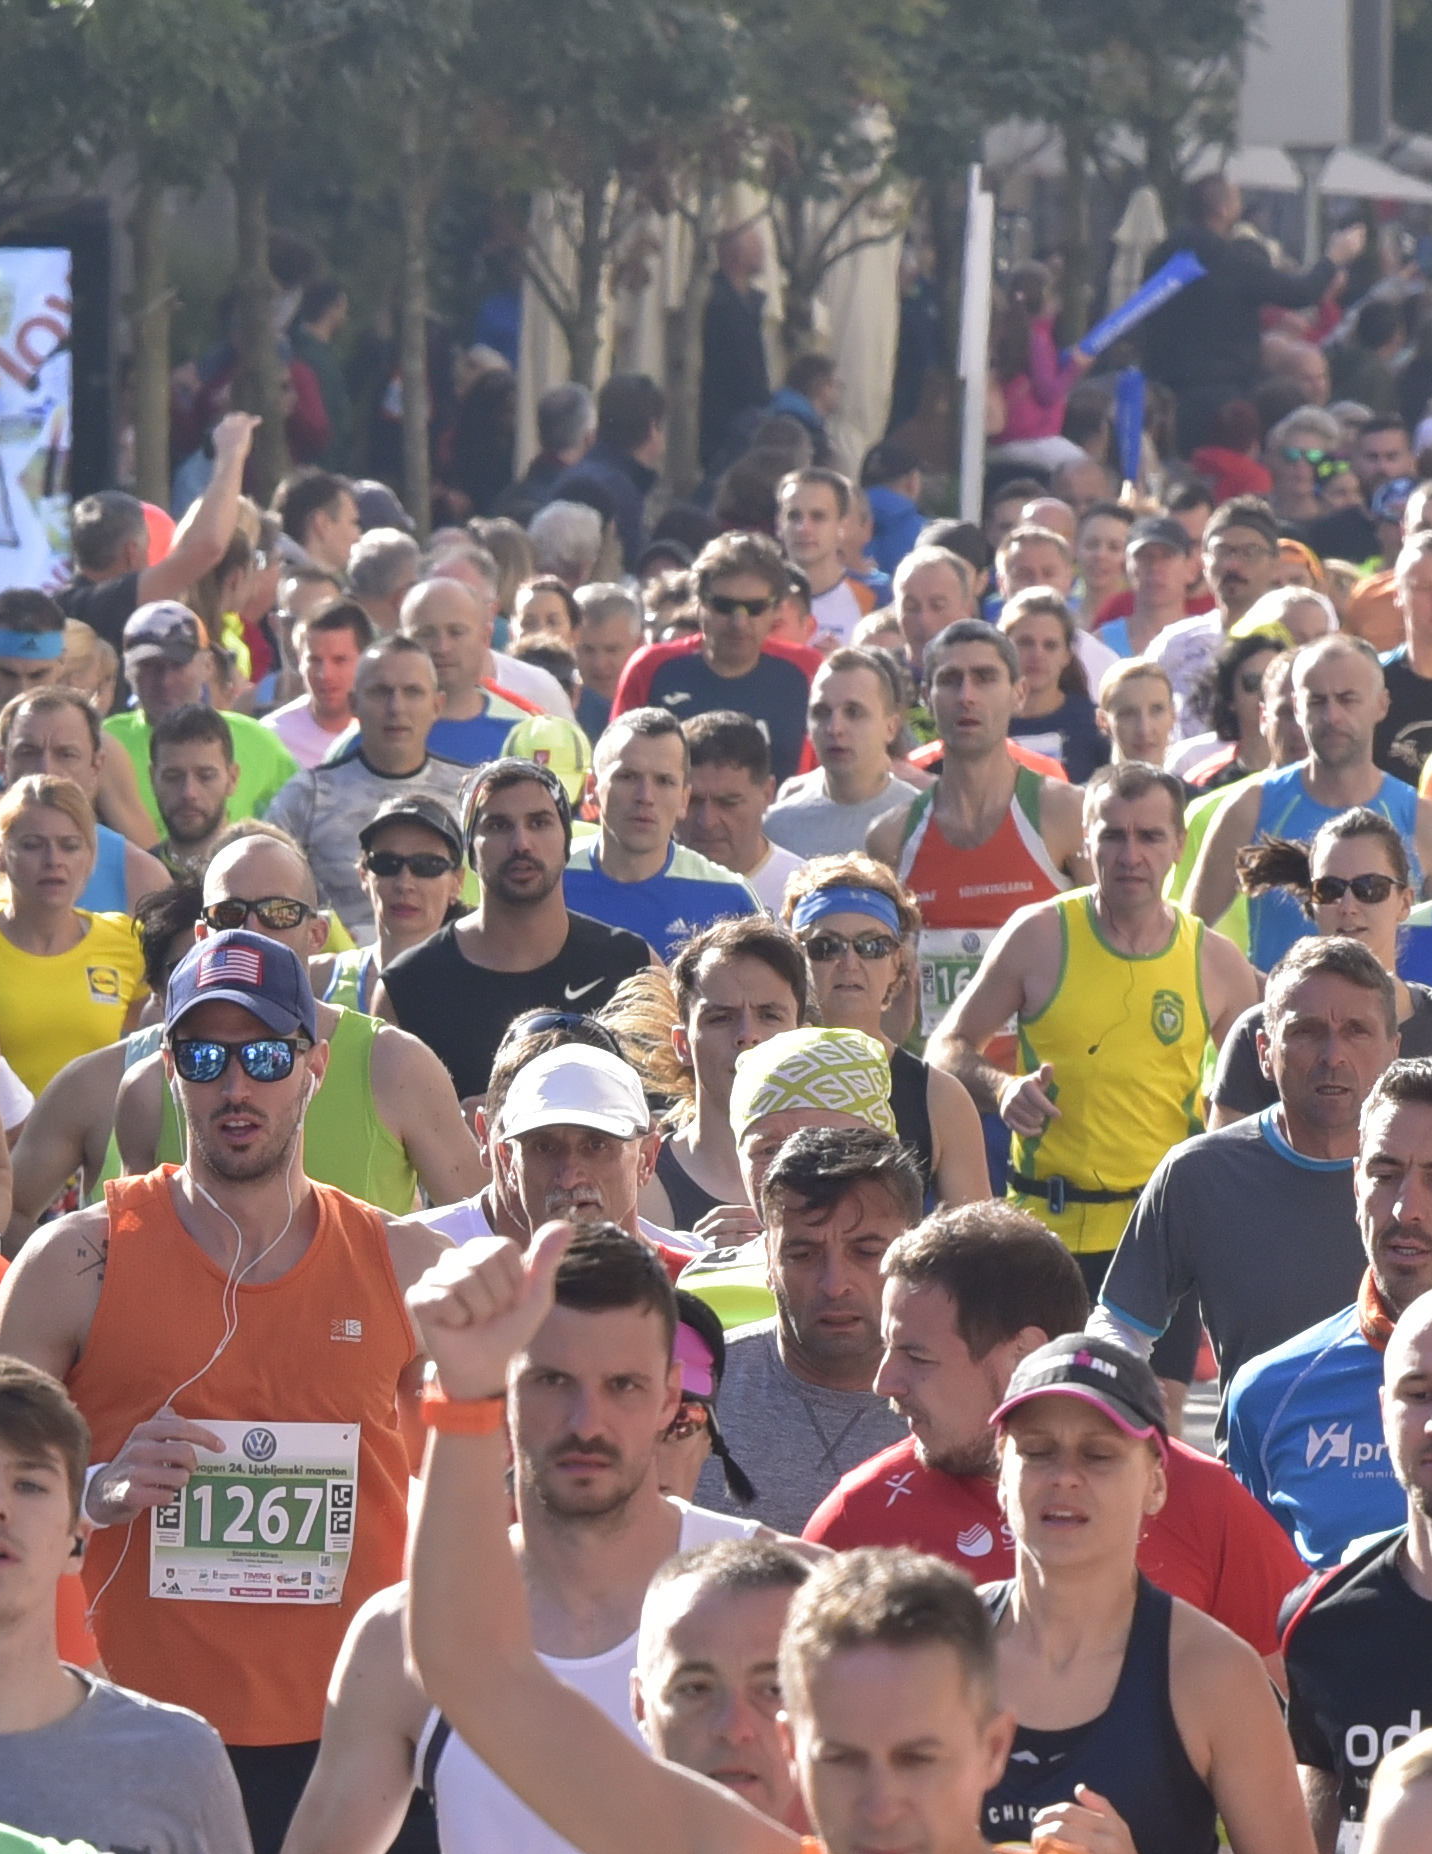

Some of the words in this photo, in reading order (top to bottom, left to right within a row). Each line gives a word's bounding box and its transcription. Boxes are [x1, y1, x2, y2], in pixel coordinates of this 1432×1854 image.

[228, 1463, 246, 1476] 24.
[249, 1463, 304, 1481] Ljubljanski
[306, 1465, 347, 1477] maraton
[192, 1484, 323, 1544] 1267
